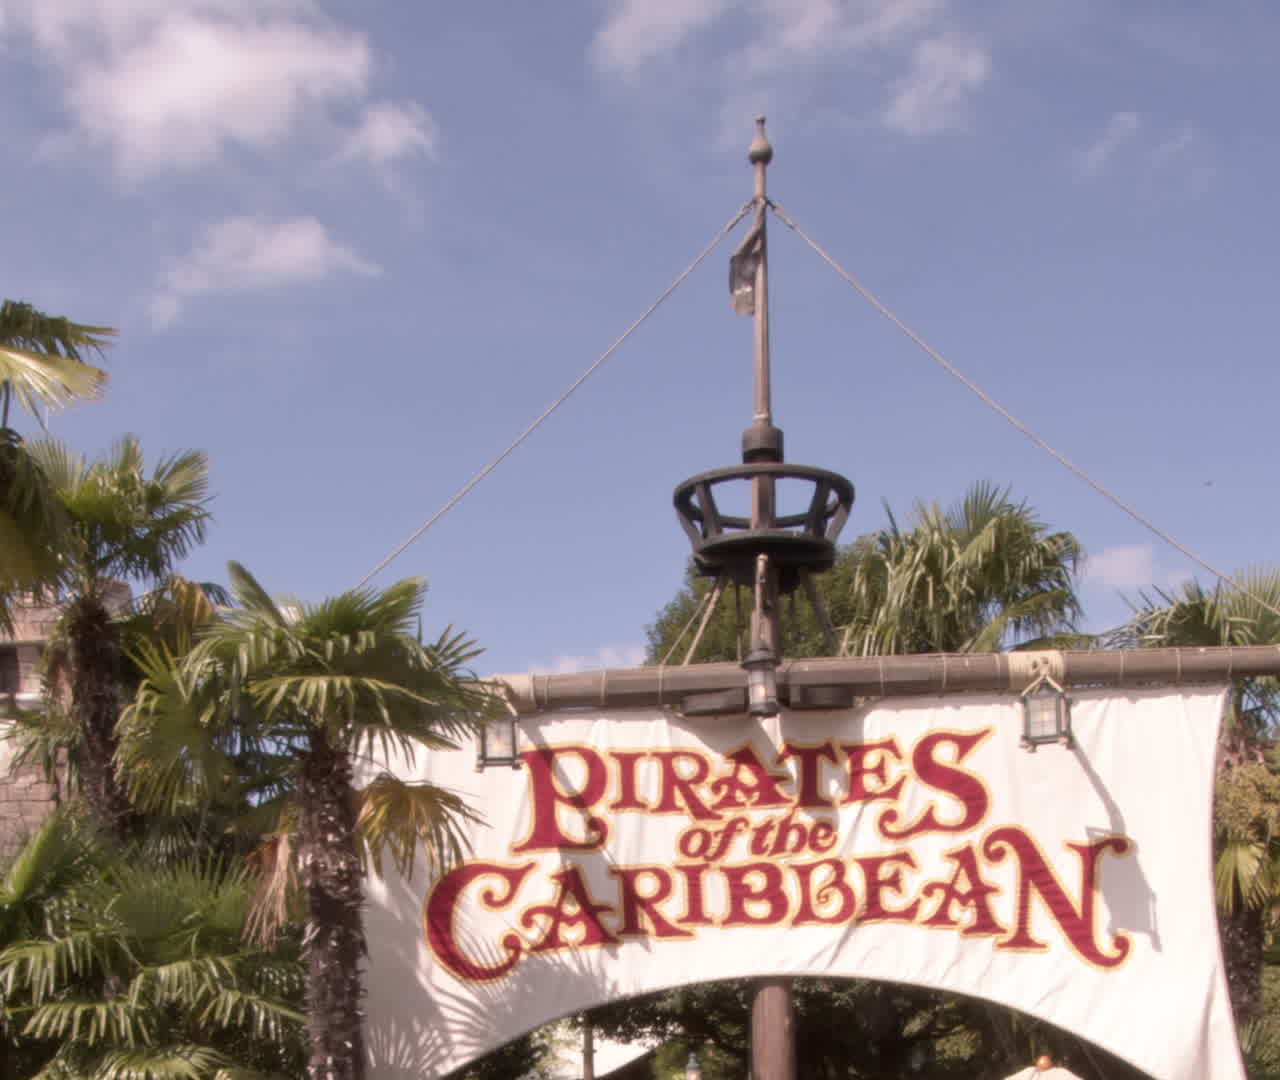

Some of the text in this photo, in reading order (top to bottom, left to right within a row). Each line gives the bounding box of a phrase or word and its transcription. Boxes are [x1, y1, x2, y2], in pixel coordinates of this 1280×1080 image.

[511, 726, 994, 854] PIRATES
[678, 806, 839, 862] of the
[424, 824, 1132, 984] CARIBBEAN
